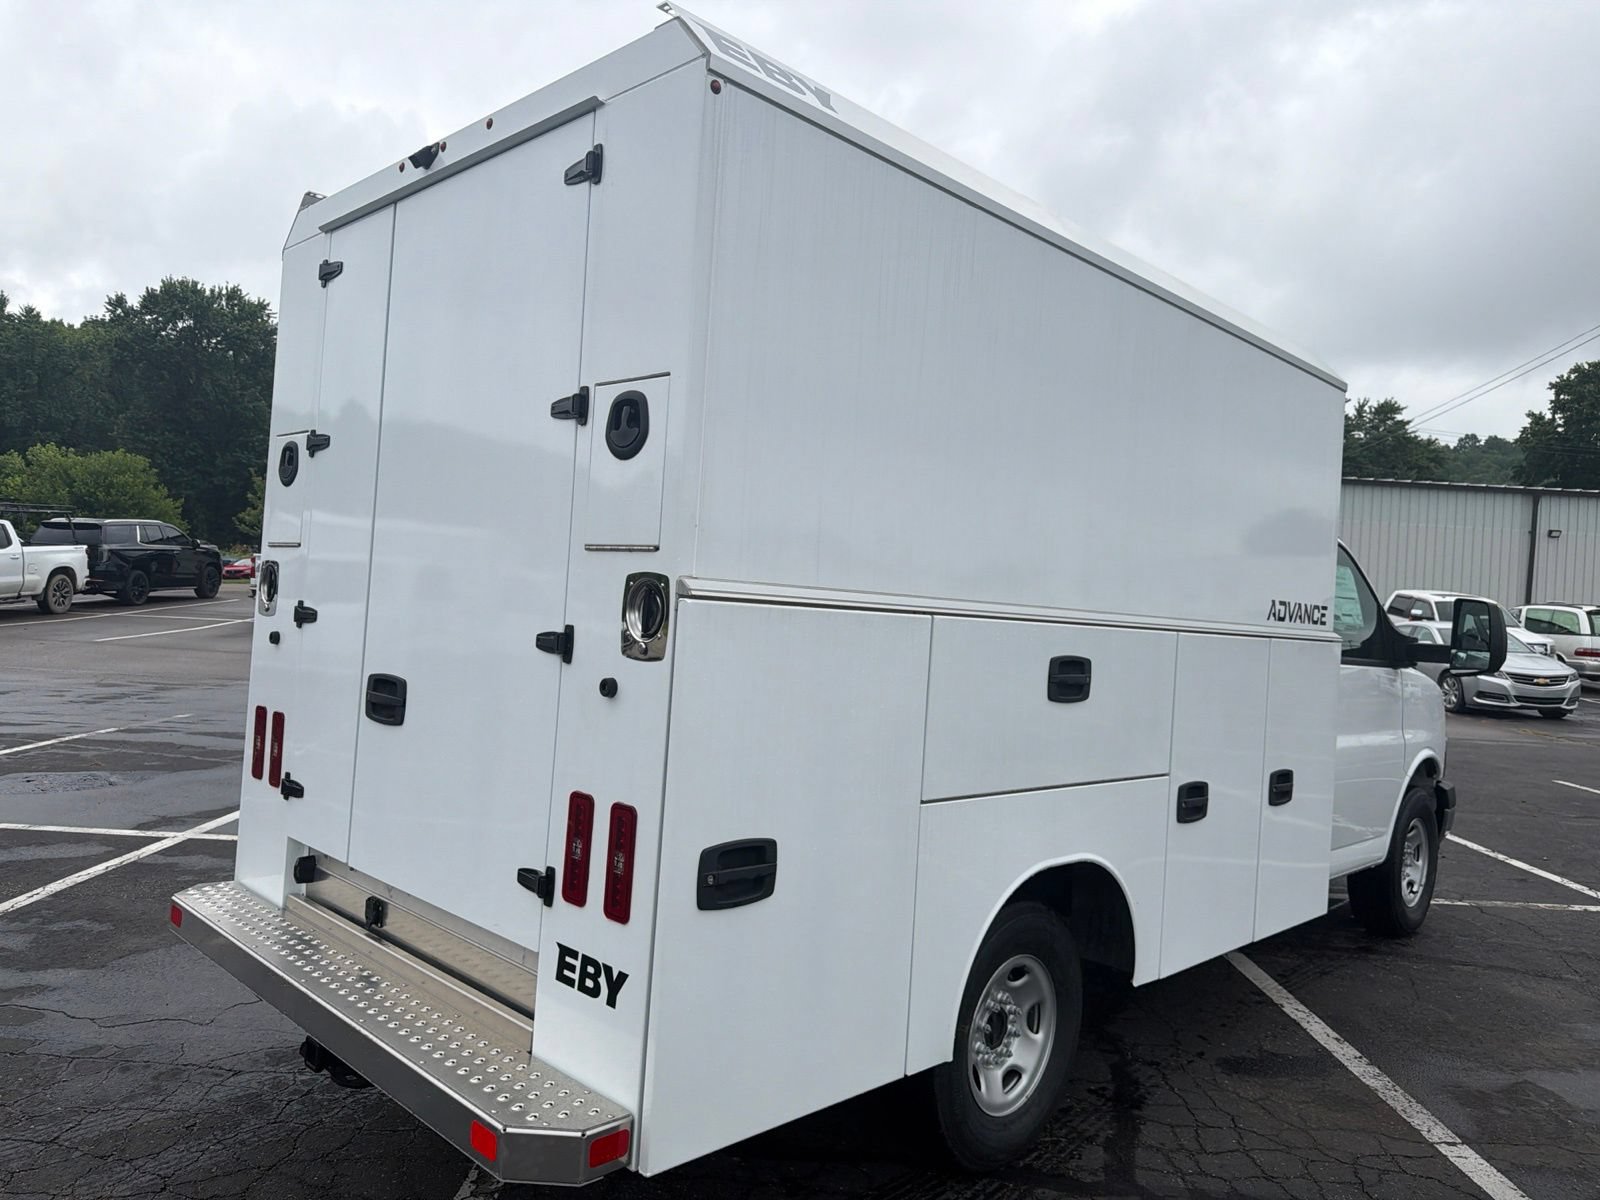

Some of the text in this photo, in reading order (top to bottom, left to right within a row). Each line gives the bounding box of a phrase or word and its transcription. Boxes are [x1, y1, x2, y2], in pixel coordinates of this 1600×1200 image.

[689, 17, 838, 114] EBY
[1267, 599, 1328, 626] ADVANCE
[555, 941, 629, 1009] EBY
